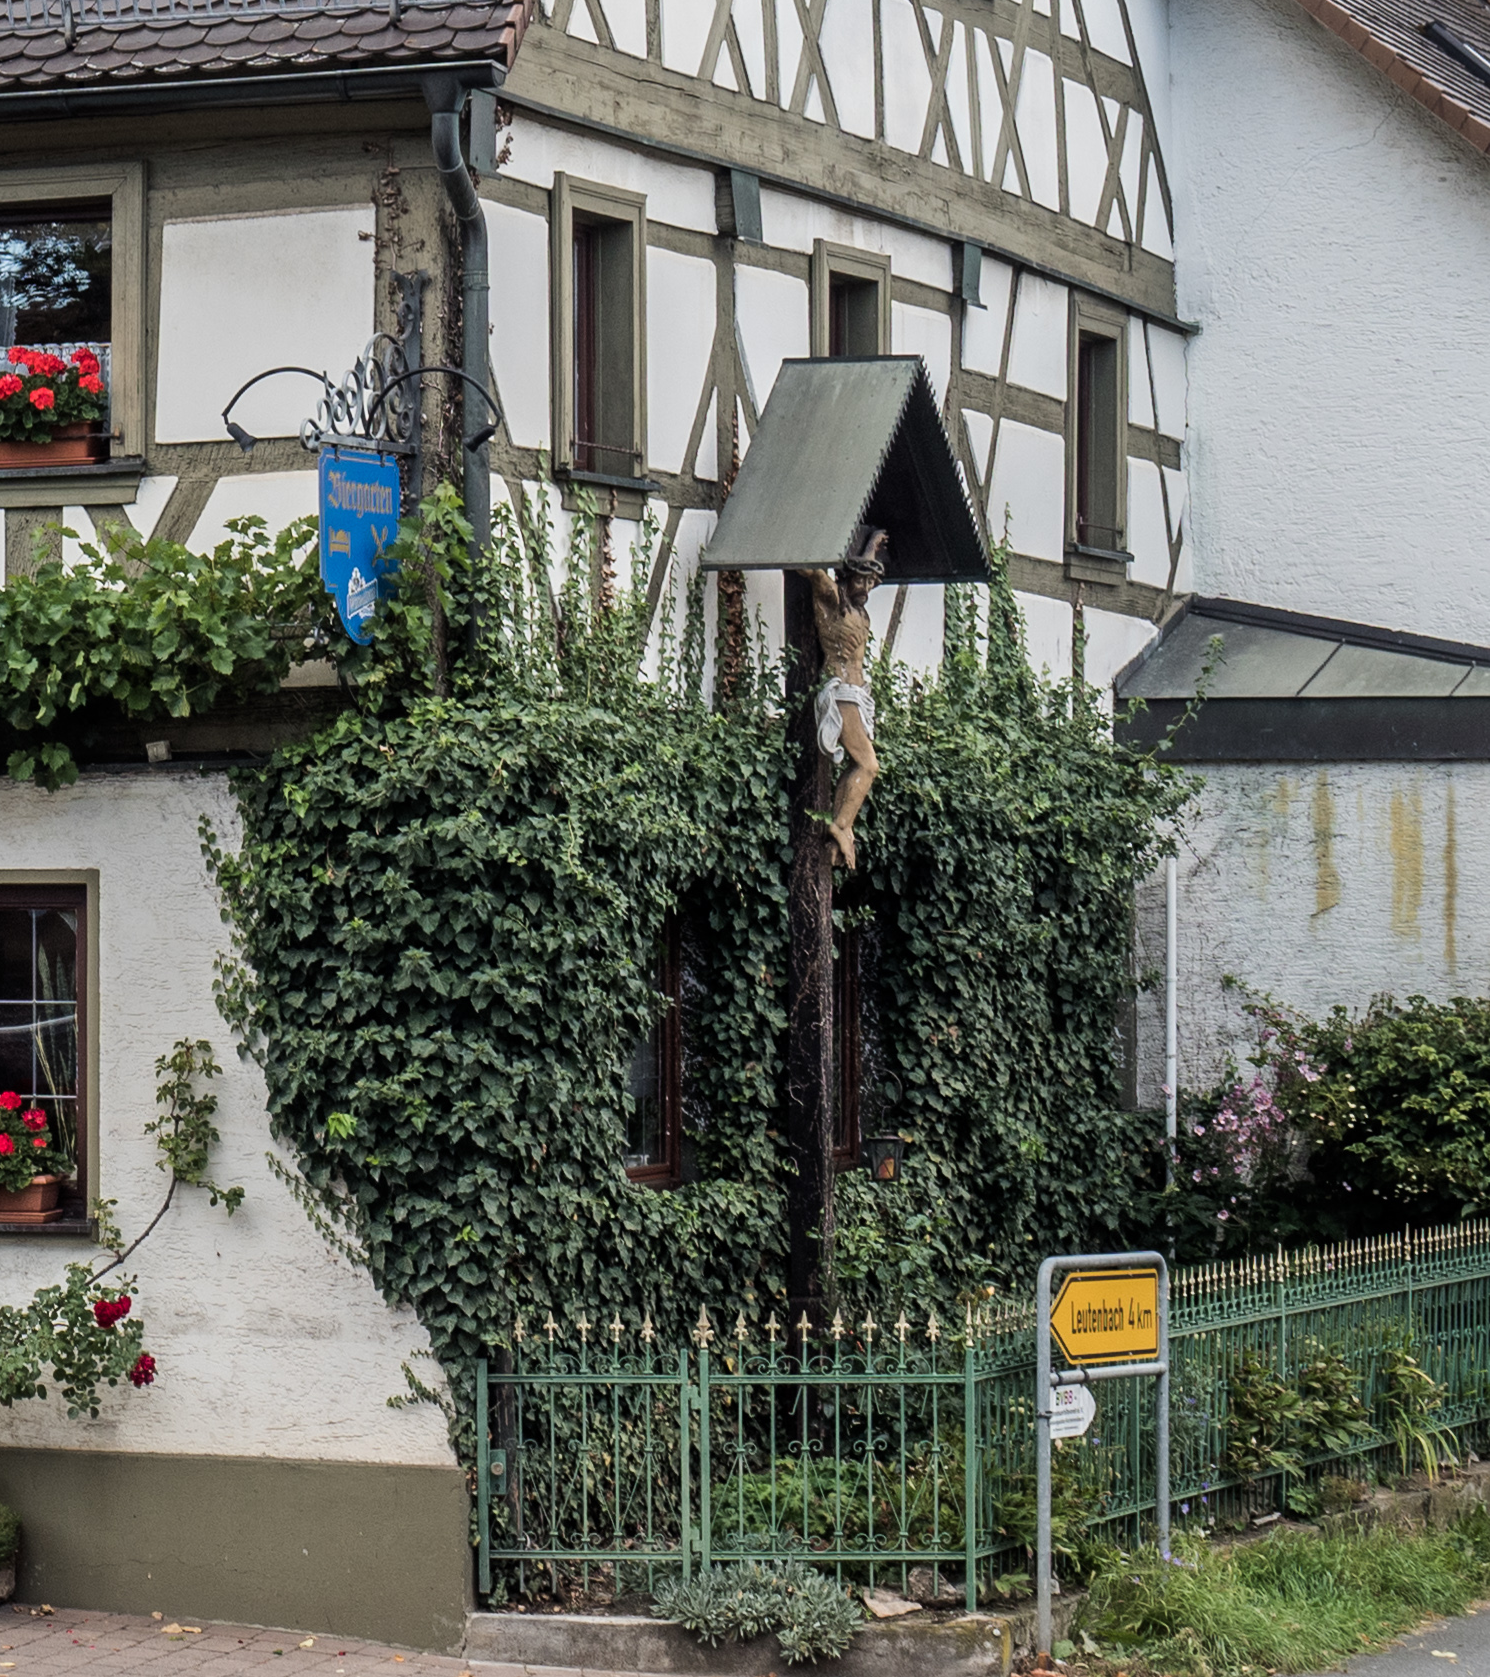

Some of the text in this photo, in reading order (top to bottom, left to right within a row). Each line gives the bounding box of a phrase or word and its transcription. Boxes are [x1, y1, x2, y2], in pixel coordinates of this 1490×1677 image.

[328, 470, 393, 519] Biergarten
[1071, 1297, 1153, 1334] Leutenbach 4 km
